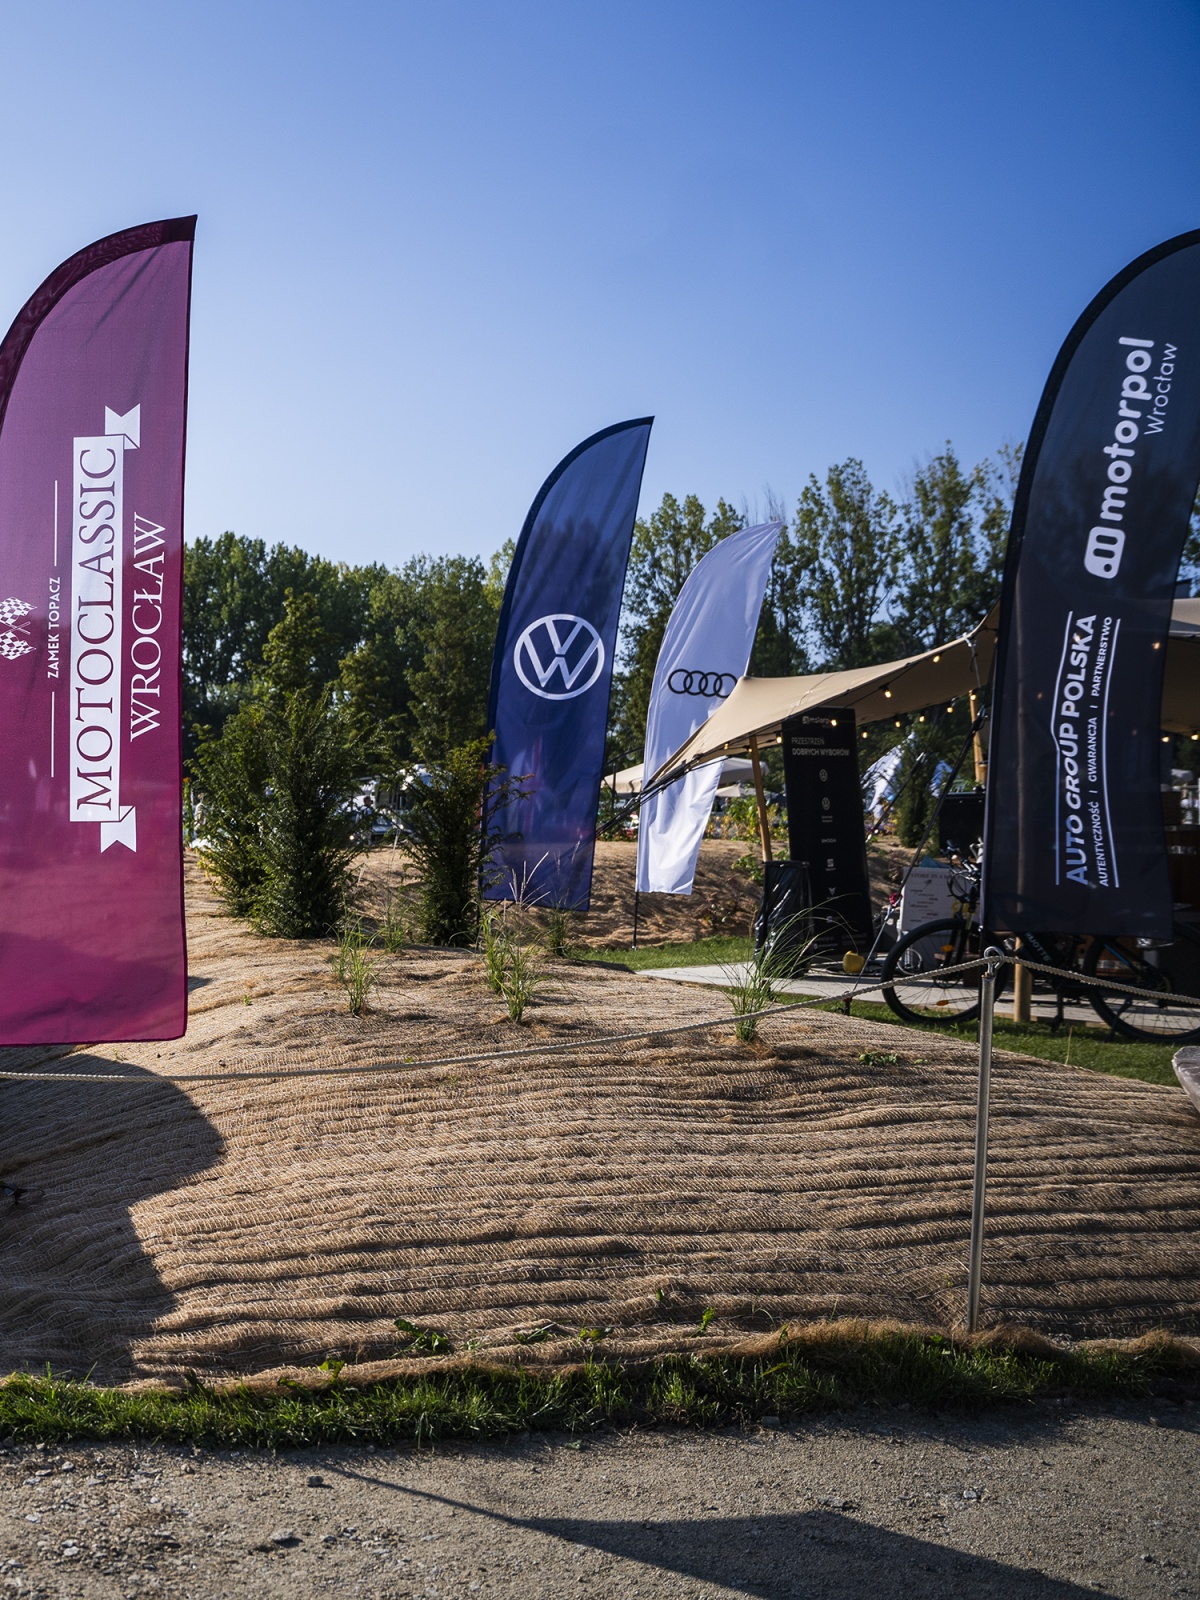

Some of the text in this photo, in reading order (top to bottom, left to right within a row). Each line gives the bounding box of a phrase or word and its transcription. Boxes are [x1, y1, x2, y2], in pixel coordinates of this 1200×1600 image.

[1099, 336, 1155, 522] motorpol
[47, 576, 61, 679] ZAMEK TOPACZ
[75, 447, 117, 812] MOTOCLASSIC
[130, 511, 167, 743] WROCŁAW
[1058, 614, 1098, 886] AUTO GROUP POLSKA
[1087, 616, 1113, 888] AUTENTYCZNOŚĆ GWARANCJA PARTNERSTWO
